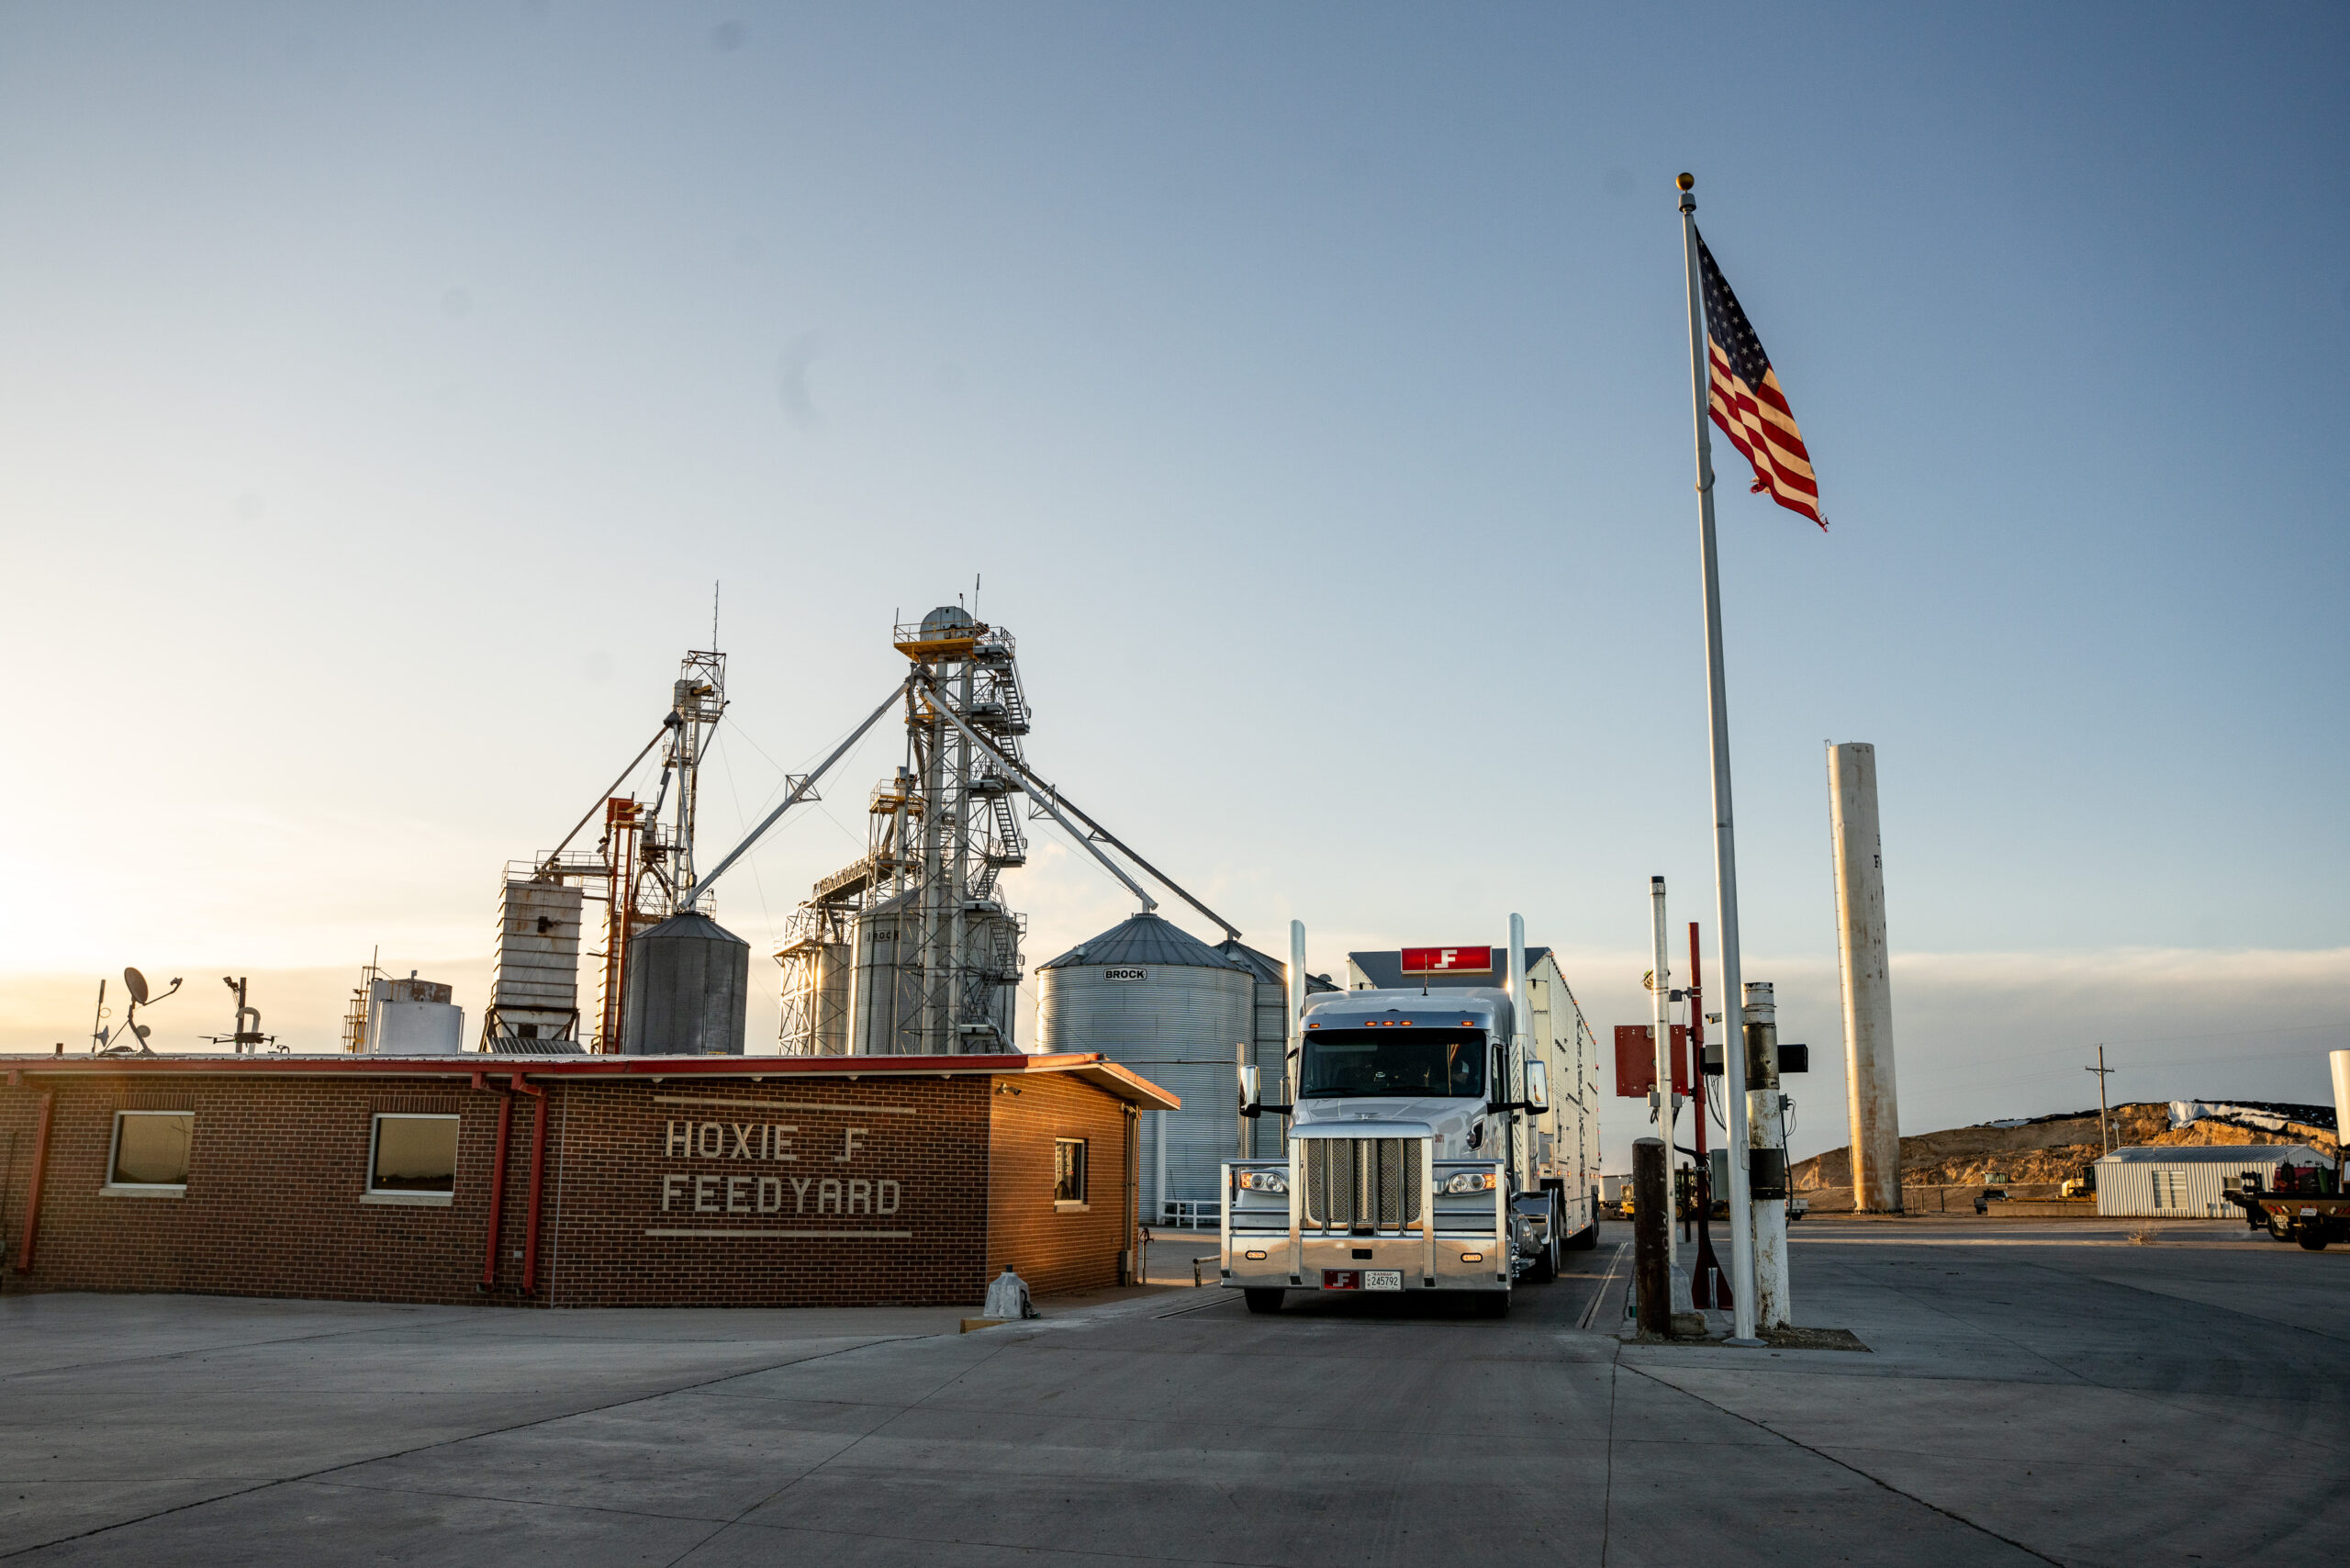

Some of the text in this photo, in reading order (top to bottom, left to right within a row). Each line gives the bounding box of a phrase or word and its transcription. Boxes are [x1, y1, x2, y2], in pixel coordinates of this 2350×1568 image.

[1105, 969, 1145, 979] BROCK
[665, 1120, 798, 1160] HOXIE
[662, 1174, 901, 1215] FEEDYARD
[1371, 1276, 1398, 1286] 245792
